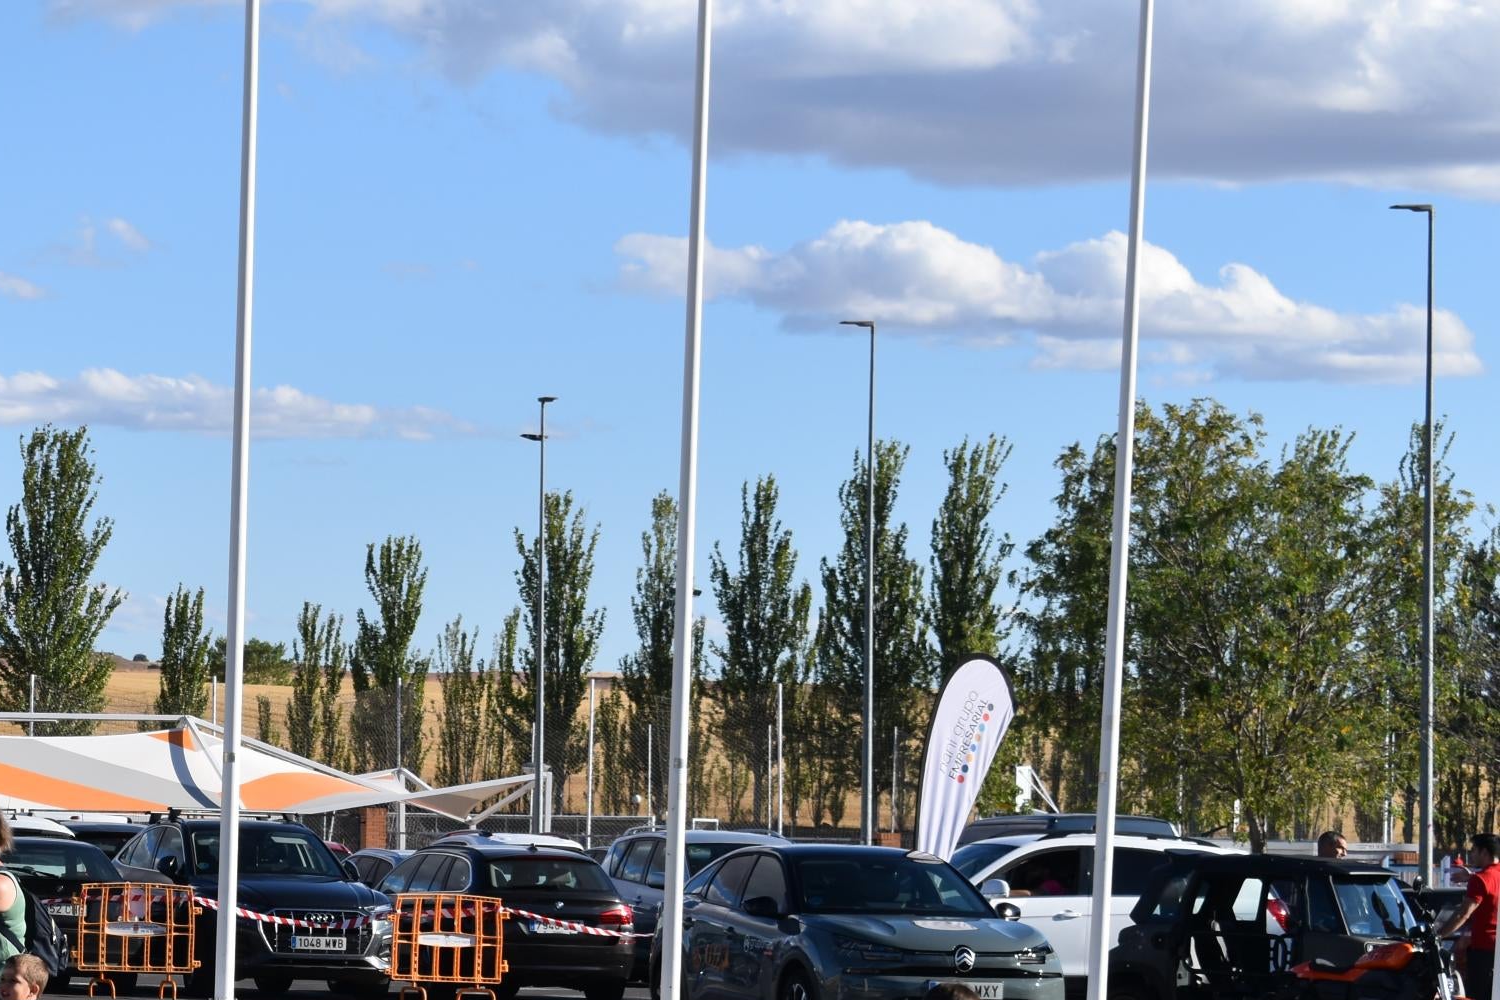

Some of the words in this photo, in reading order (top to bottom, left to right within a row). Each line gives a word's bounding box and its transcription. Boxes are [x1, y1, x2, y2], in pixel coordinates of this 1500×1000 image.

[953, 690, 979, 739] grupo
[948, 699, 989, 780] EMPRESARIAL
[299, 938, 322, 948] 1048
